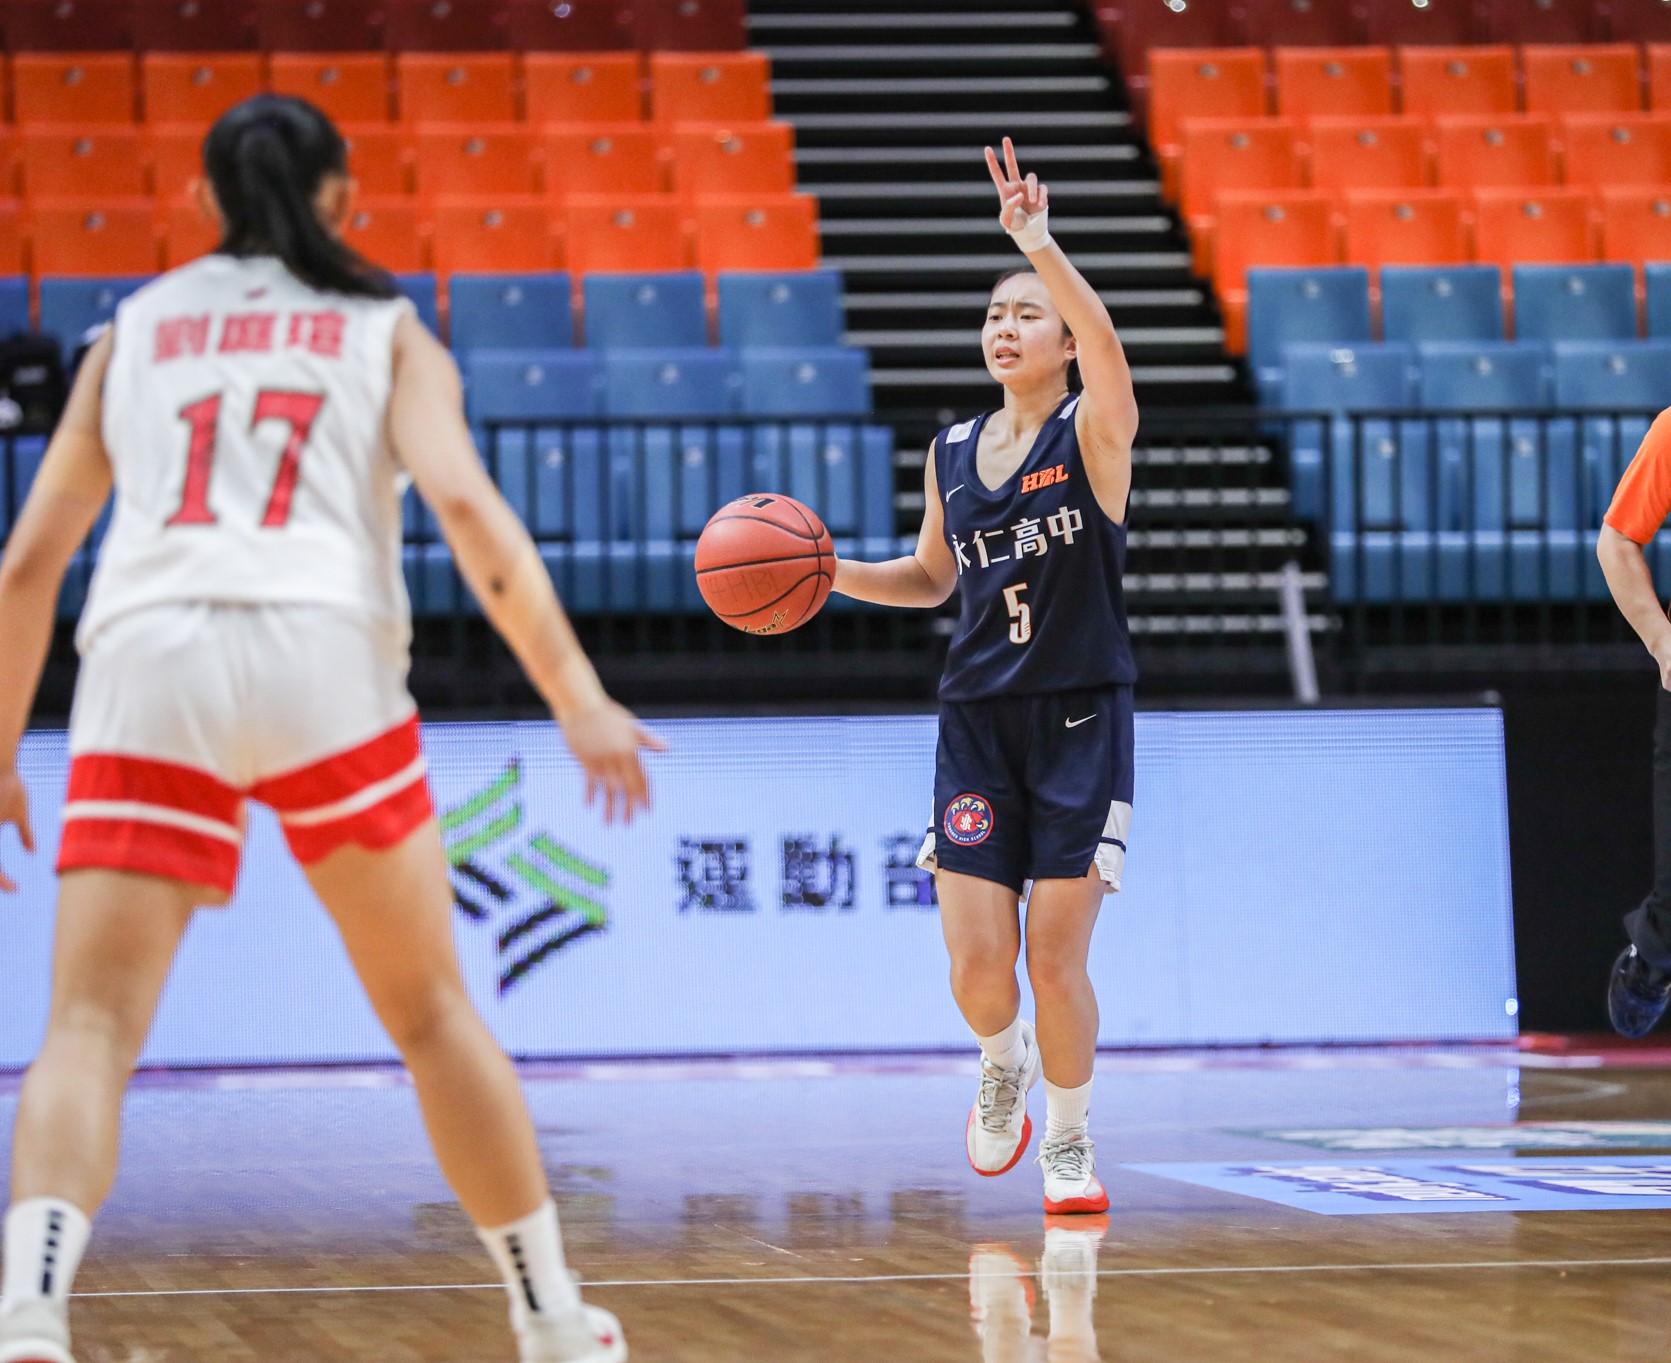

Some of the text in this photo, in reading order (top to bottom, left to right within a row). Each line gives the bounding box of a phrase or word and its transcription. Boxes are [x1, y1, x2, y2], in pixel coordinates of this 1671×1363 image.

[164, 388, 327, 529] 17
[1021, 463, 1069, 494] HBL
[952, 505, 1084, 576] 永仁高中
[1003, 582, 1033, 644] 5
